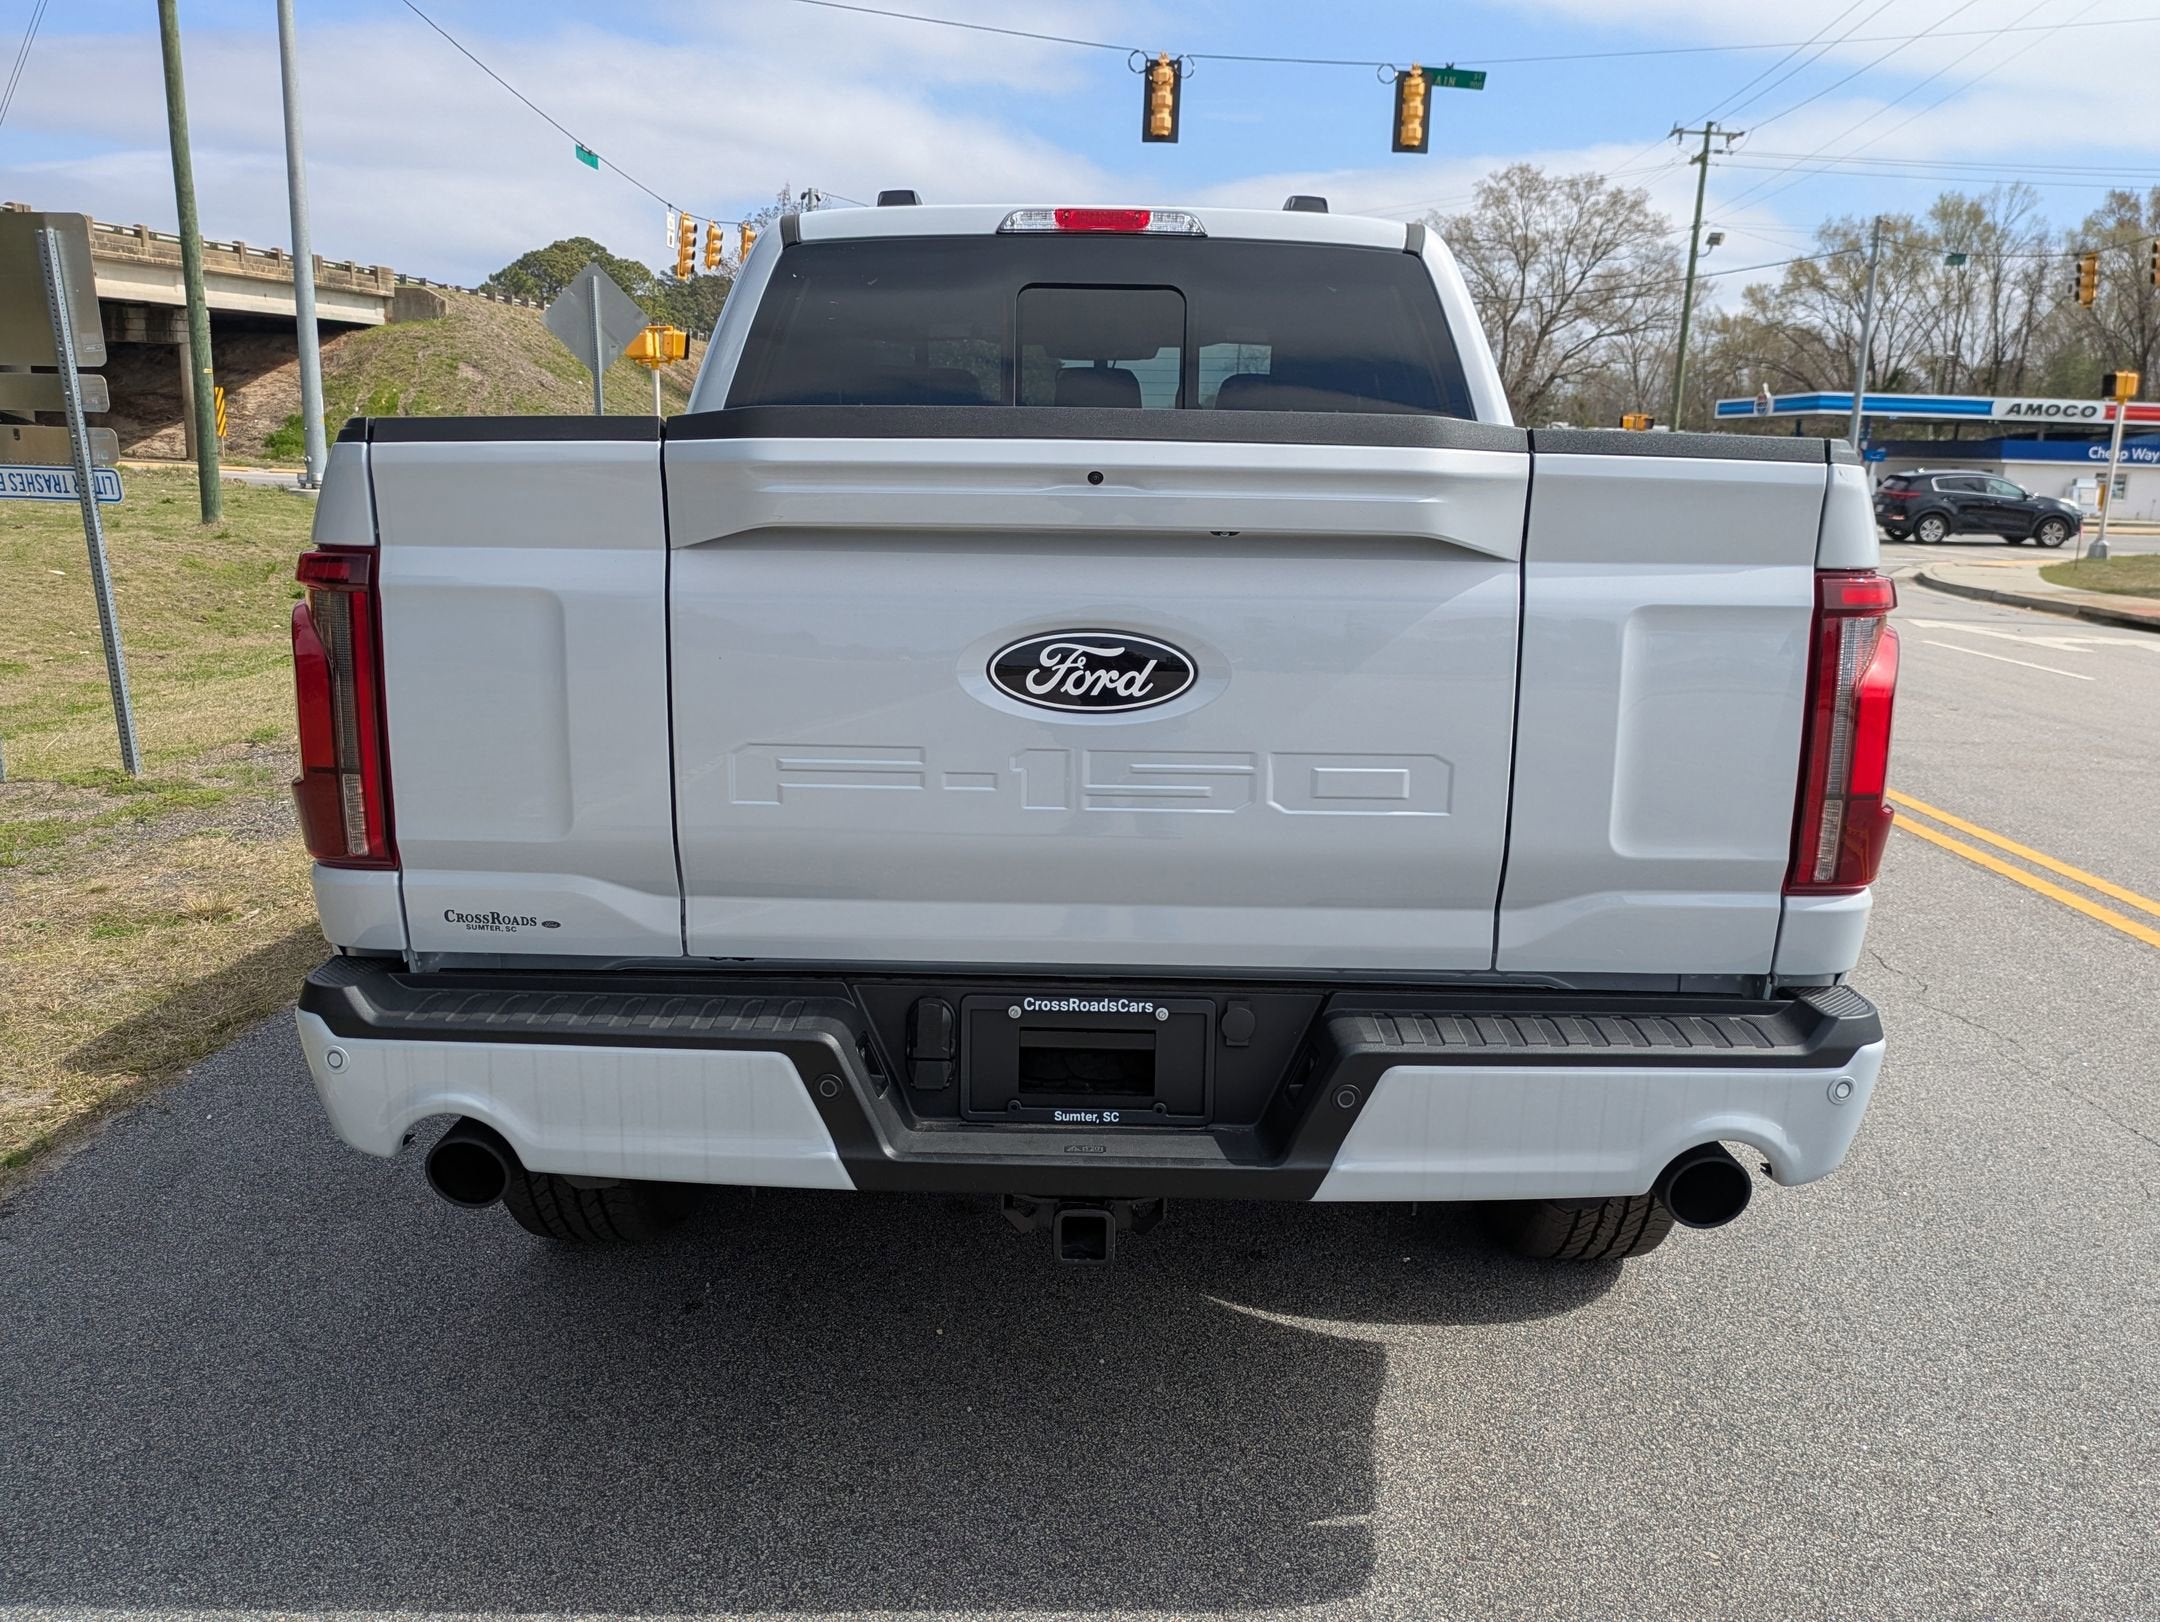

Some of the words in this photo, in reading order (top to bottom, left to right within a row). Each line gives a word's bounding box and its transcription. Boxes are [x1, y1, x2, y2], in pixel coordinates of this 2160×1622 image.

[2005, 402, 2098, 419] AMOCO
[2088, 446, 2130, 462] Chep
[2131, 447, 2160, 464] Way
[8, 472, 71, 494] TRASHES
[72, 474, 115, 496] LITR
[1025, 642, 1157, 700] Ford
[728, 742, 1456, 816] F-150
[505, 925, 518, 933] SC
[1023, 997, 1154, 1014] CrossRoadsCars
[1054, 1110, 1100, 1124] Sumter,
[1102, 1111, 1120, 1123] SC
